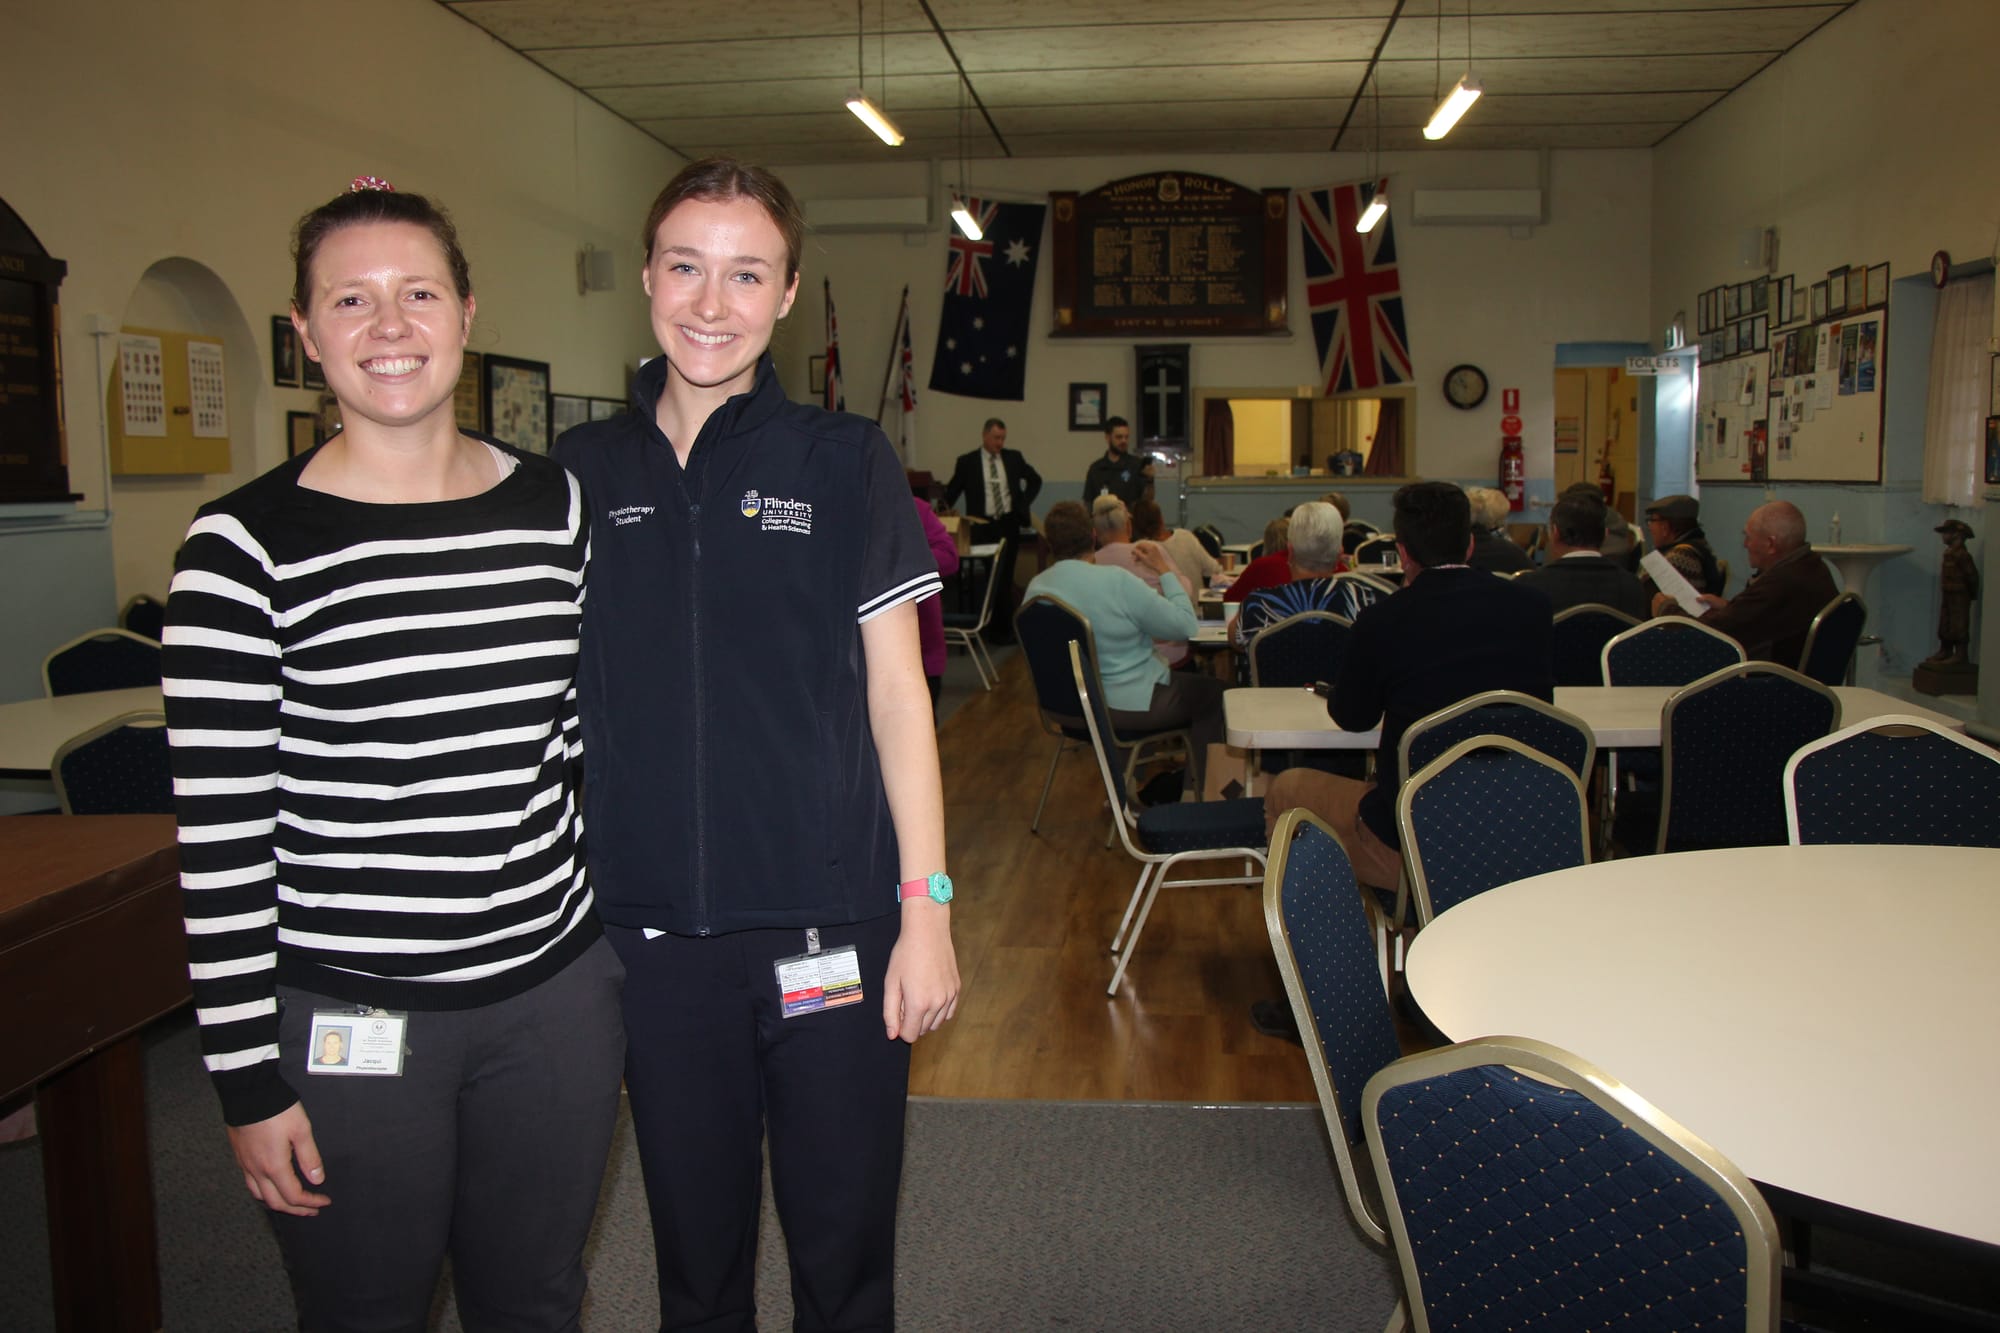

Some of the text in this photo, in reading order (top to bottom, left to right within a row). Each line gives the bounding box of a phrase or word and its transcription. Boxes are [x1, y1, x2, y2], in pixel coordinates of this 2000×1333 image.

[1185, 177, 1221, 193] ROLL
[1628, 357, 1680, 369] TOILETS
[763, 497, 813, 513] Flinders
[608, 505, 656, 519] Physiotherapy
[762, 509, 812, 519] UNIVERSITY
[615, 515, 642, 526] Student
[761, 517, 782, 525] College
[790, 519, 812, 530] Nursing
[788, 525, 811, 535] Sciences
